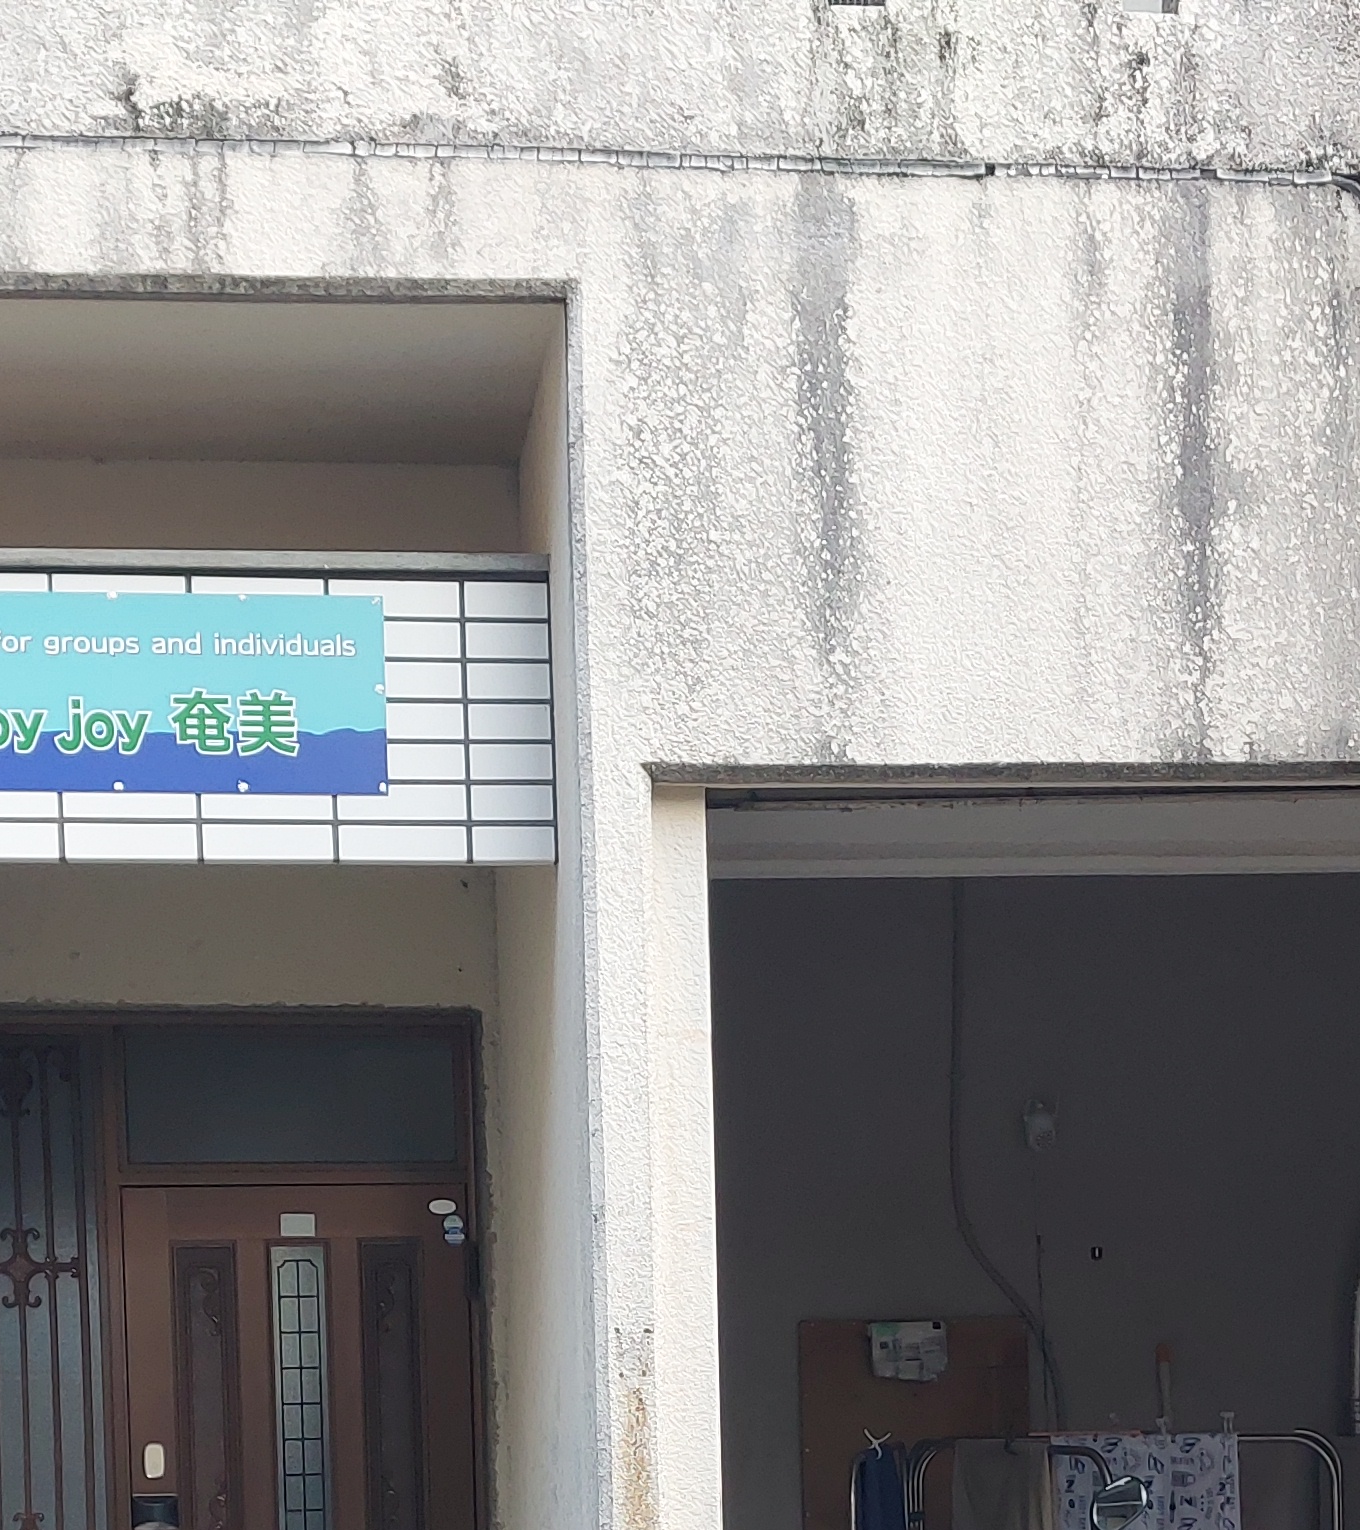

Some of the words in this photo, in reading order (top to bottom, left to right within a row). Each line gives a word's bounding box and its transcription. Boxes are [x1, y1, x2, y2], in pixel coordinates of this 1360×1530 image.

[43, 631, 141, 657] groups
[150, 631, 202, 656] and
[213, 631, 357, 657] individuals
[53, 697, 151, 755] joy
[170, 688, 300, 757] 奄美
